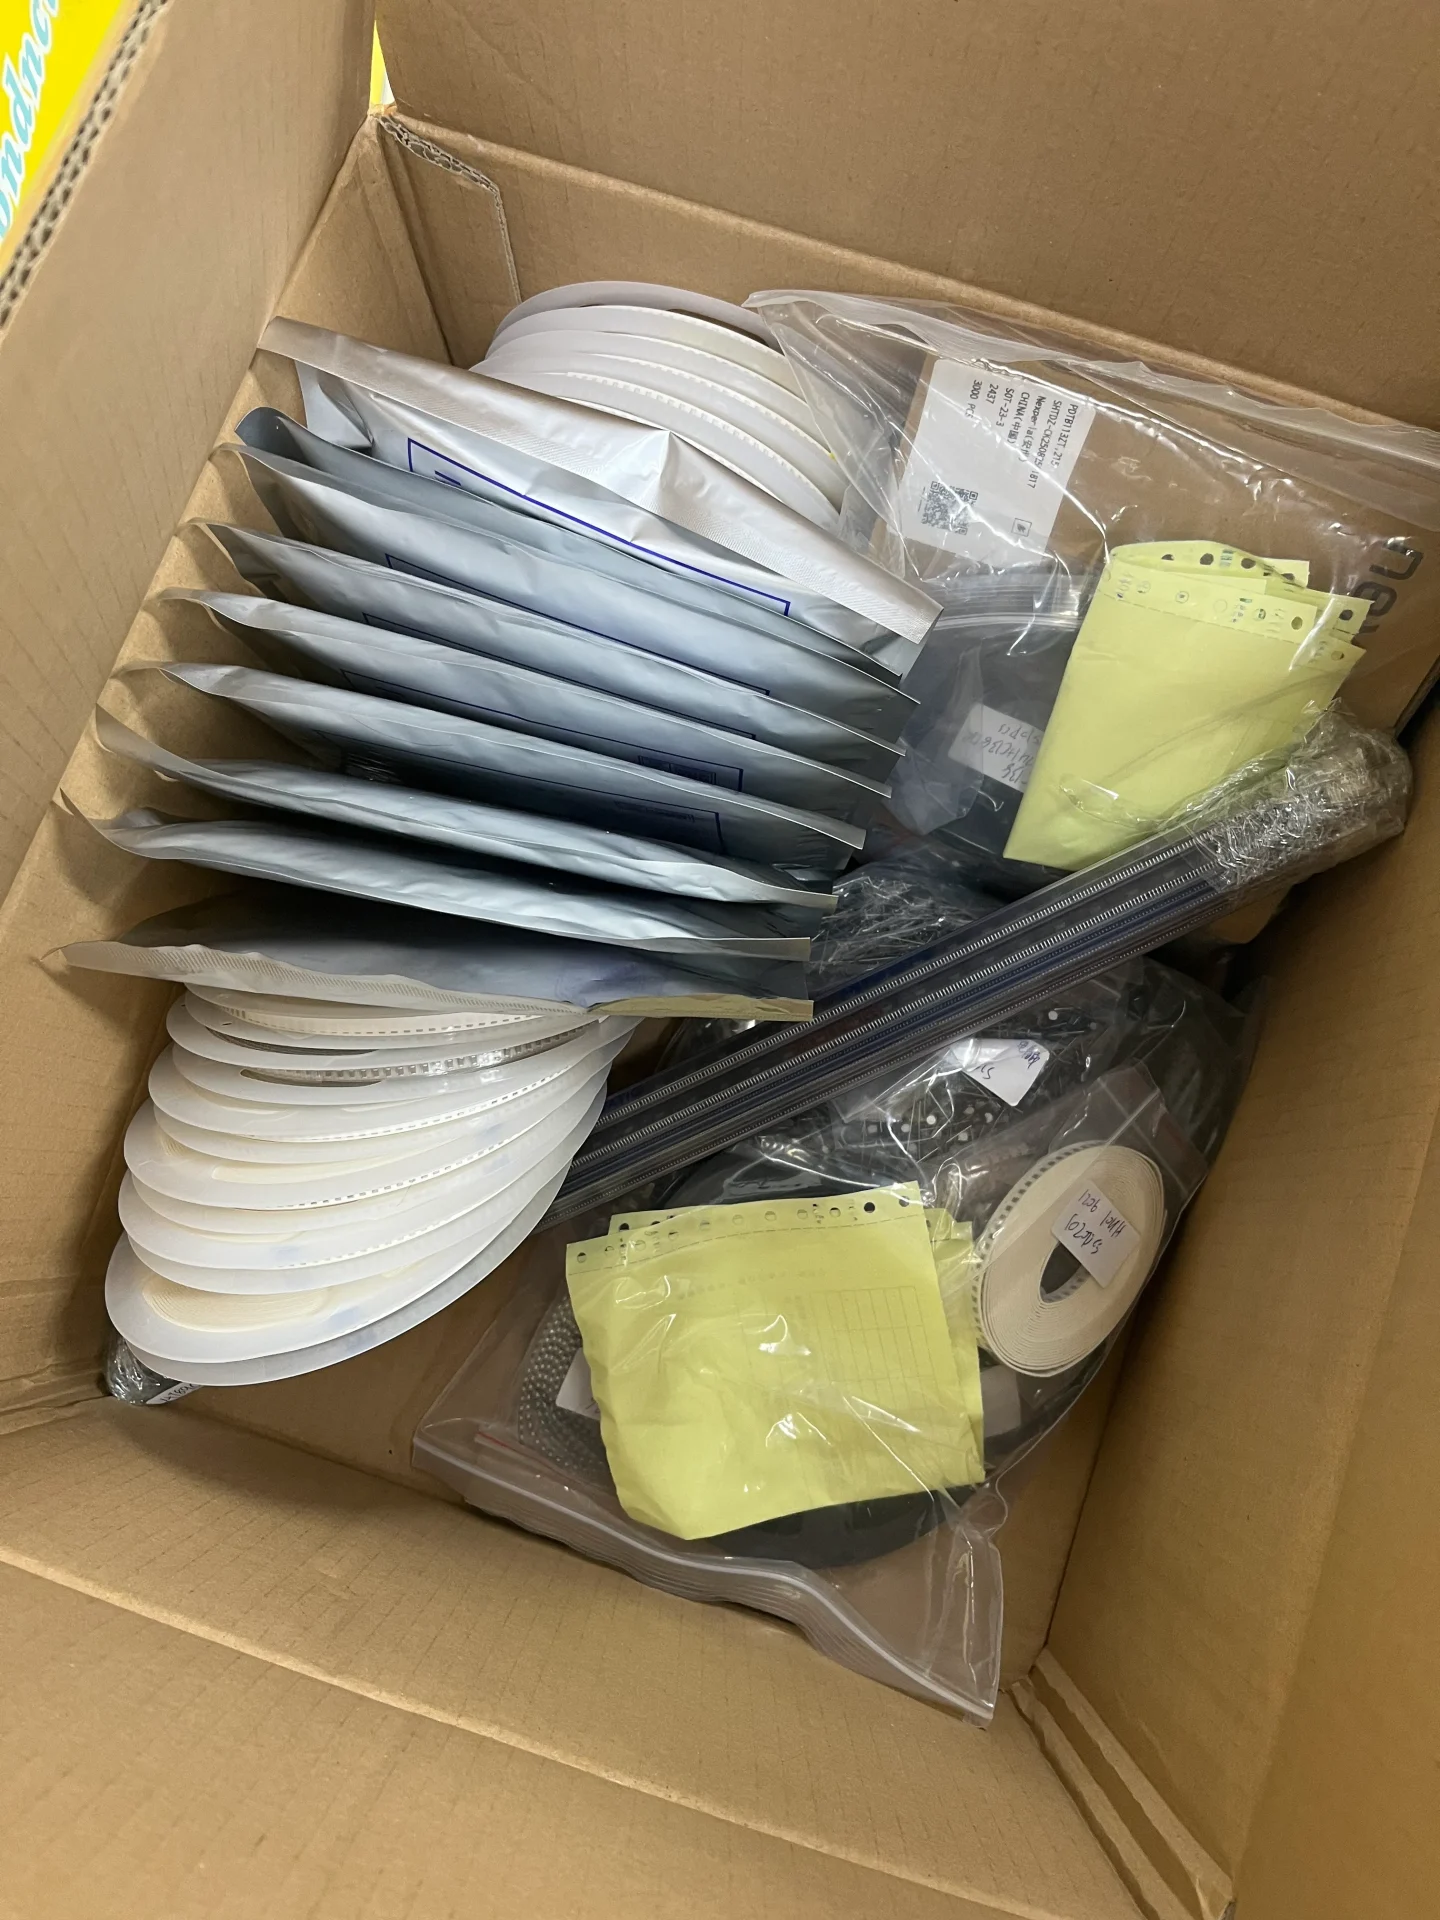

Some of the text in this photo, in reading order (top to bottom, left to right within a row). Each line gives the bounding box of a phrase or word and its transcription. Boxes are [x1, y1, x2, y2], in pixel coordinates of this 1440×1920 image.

[969, 379, 982, 400] 3000
[985, 383, 998, 404] 2437
[995, 387, 1014, 427] SOT-23-3
[1078, 1189, 1100, 1212] 1206
